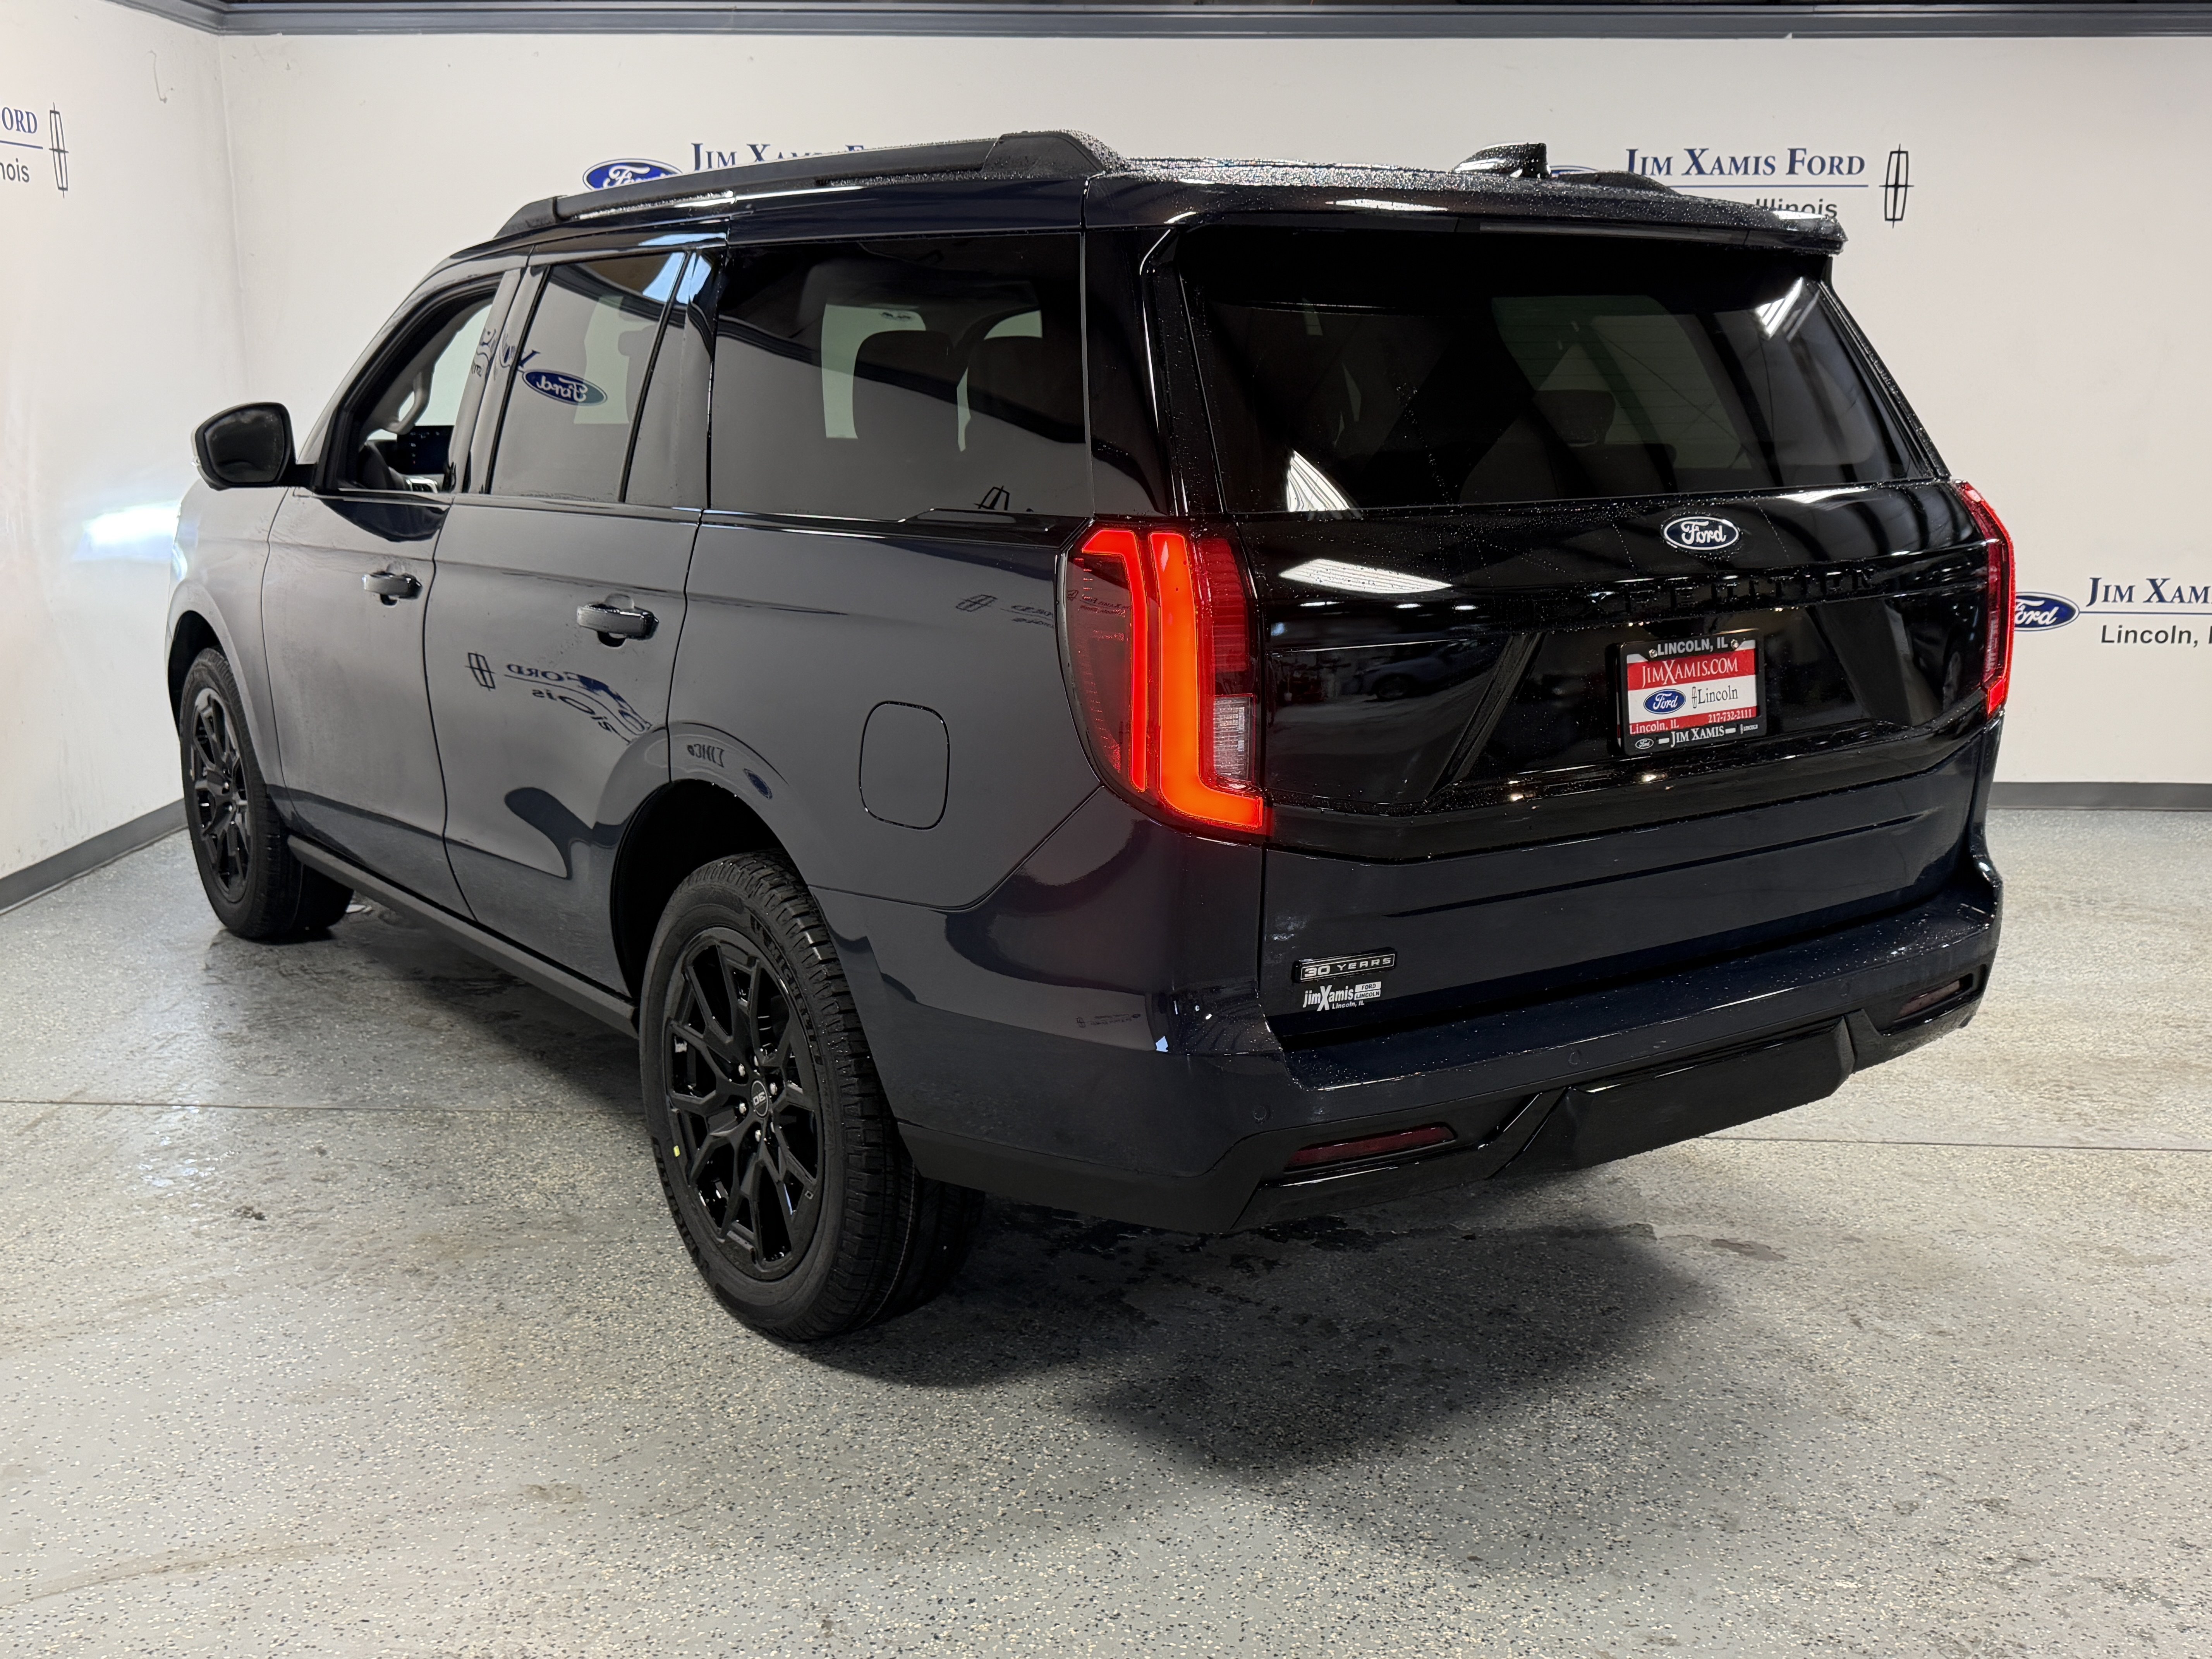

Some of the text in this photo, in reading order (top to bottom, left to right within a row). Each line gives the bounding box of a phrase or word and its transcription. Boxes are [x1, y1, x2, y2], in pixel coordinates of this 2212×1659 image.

[2, 107, 38, 134] ORD
[1626, 148, 1865, 176] JIM XAMIS FORD
[1681, 521, 1726, 544] Ford
[2086, 577, 2212, 607] JIM XAM
[1657, 637, 1728, 656] LINCOLN, IL
[2101, 625, 2198, 648] Lincoln,
[1642, 658, 1738, 688] JIMXAMIS.COM
[1652, 693, 1678, 710] Ford
[1697, 685, 1738, 704] Lincoln
[1671, 719, 1679, 729] IL
[1708, 709, 1752, 723] 217-732-2111
[1671, 726, 1725, 748] JIM XAMIS
[1304, 957, 1391, 977] 30 YEARS
[1303, 985, 1354, 1011] jimXamis
[1332, 1001, 1357, 1009] Lincoln,
[1356, 990, 1380, 999] LINCOLN
